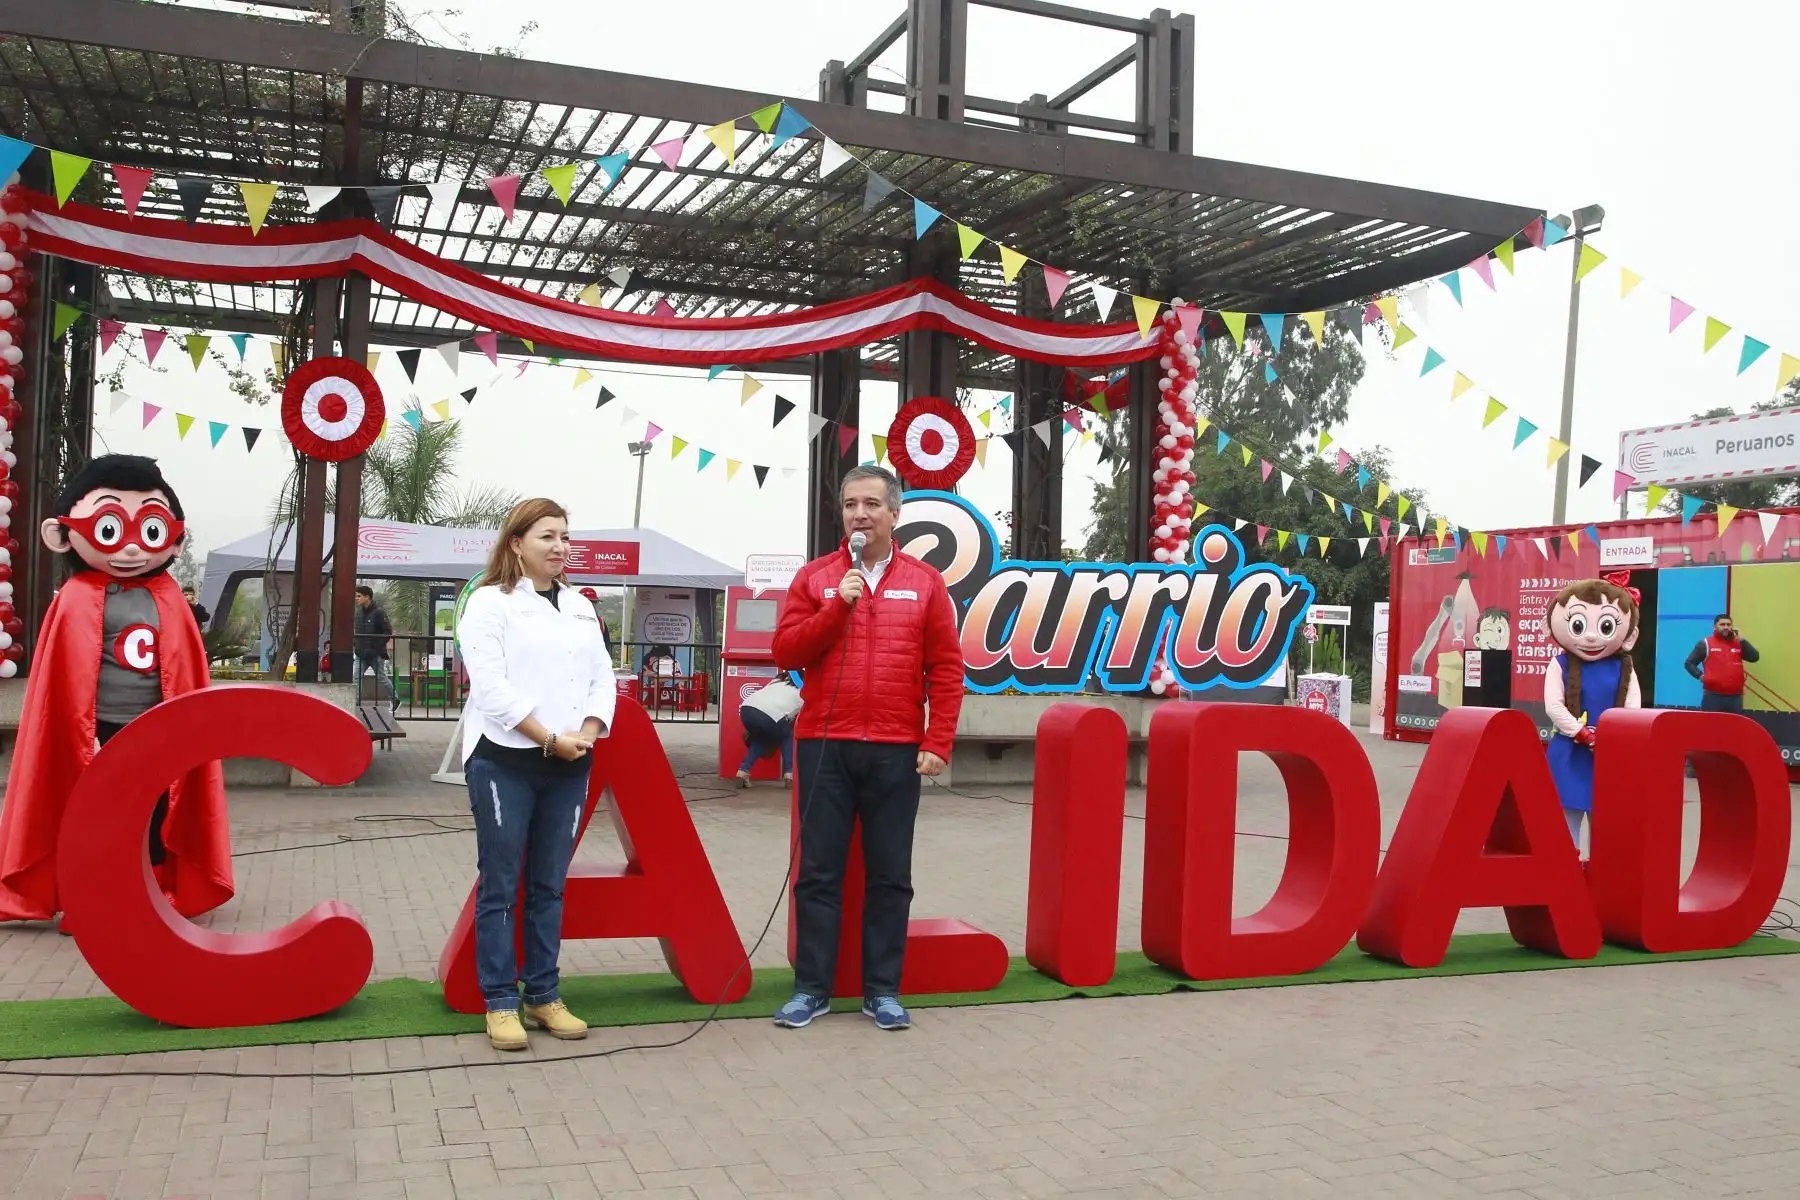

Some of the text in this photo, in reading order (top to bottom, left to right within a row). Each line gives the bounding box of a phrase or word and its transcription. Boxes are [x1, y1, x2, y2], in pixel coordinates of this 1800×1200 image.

[1715, 433, 1795, 455] Peruanos
[1662, 446, 1697, 458] INACAL
[594, 553, 628, 561] INACAL
[1605, 546, 1648, 557] ENTRADA
[1543, 596, 1550, 606] y
[1518, 619, 1543, 633] exp
[1517, 633, 1545, 644] que te
[123, 628, 155, 669] C
[58, 686, 1792, 1028] CALIDAD
